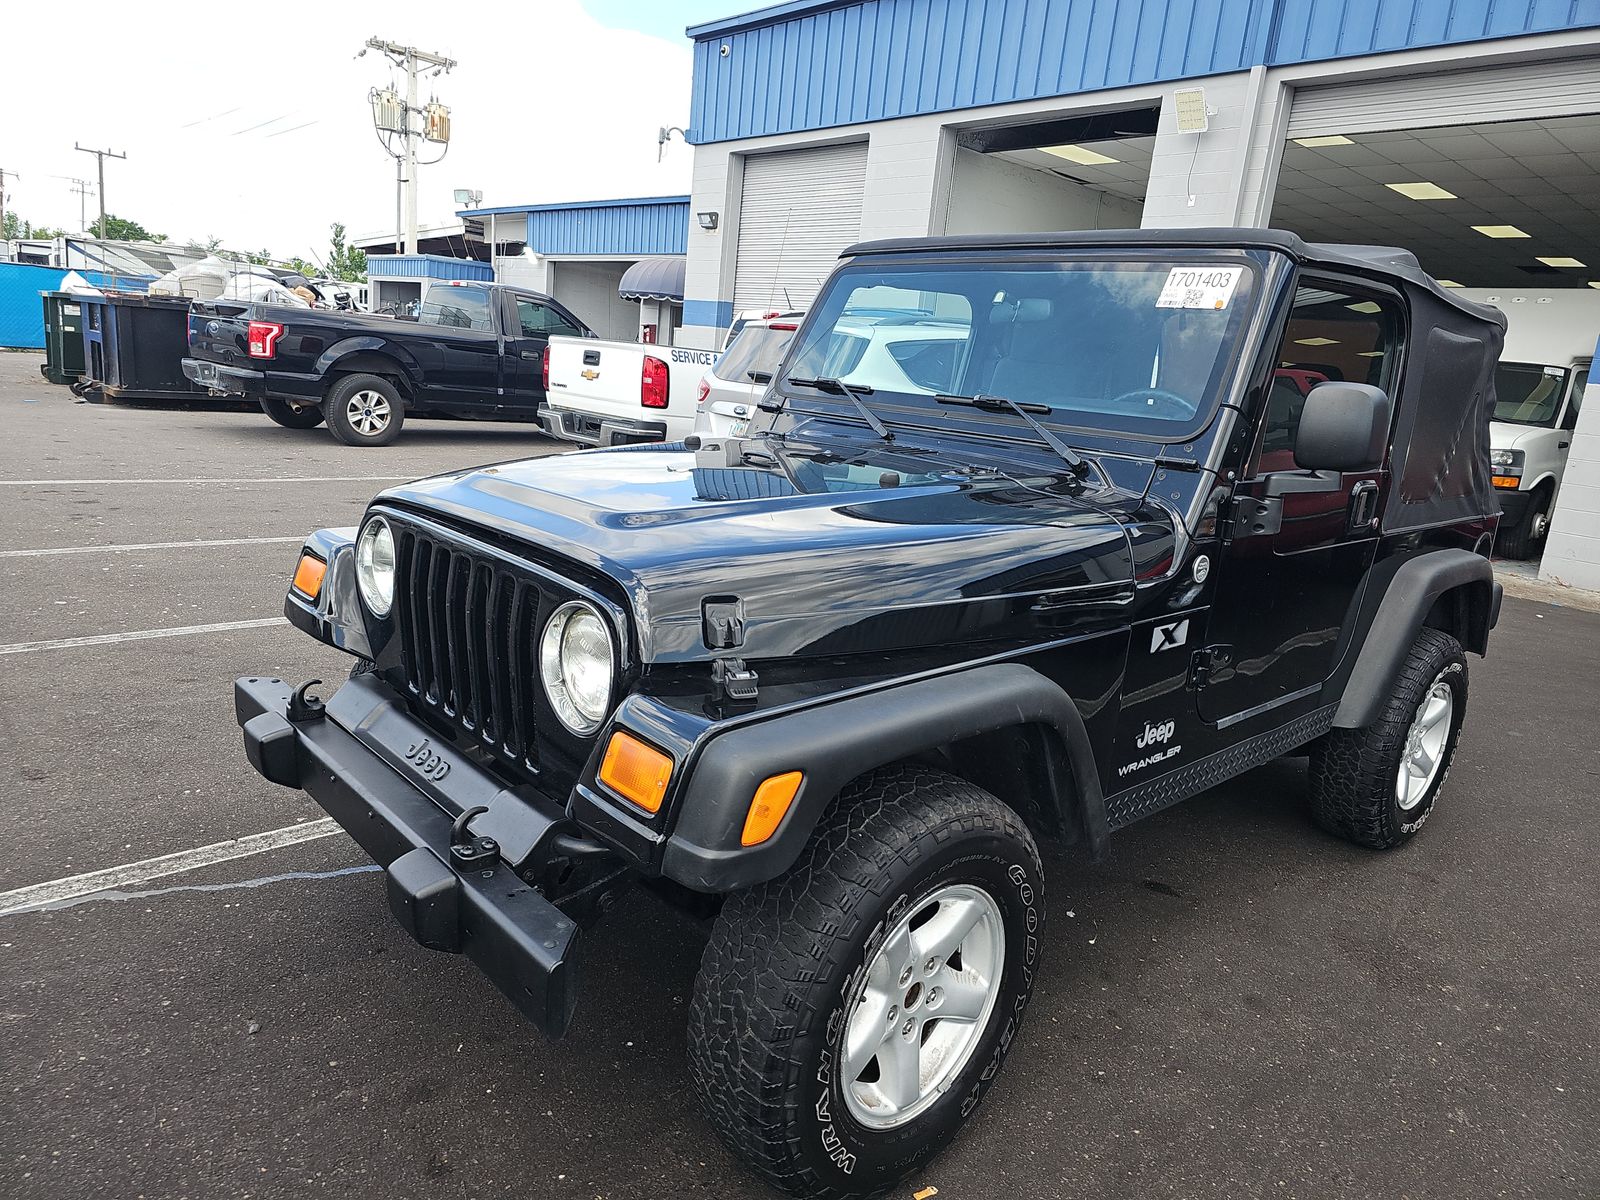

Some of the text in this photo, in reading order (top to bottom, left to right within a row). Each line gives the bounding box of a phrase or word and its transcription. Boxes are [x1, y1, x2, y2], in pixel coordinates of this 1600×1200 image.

[1169, 272, 1232, 288] 1701403
[671, 349, 712, 366] SERVICE
[1136, 720, 1175, 748] Jeep
[404, 738, 451, 783] Jeep
[1118, 745, 1182, 777] WRANGLER
[960, 864, 1037, 1118] GOODYEAR
